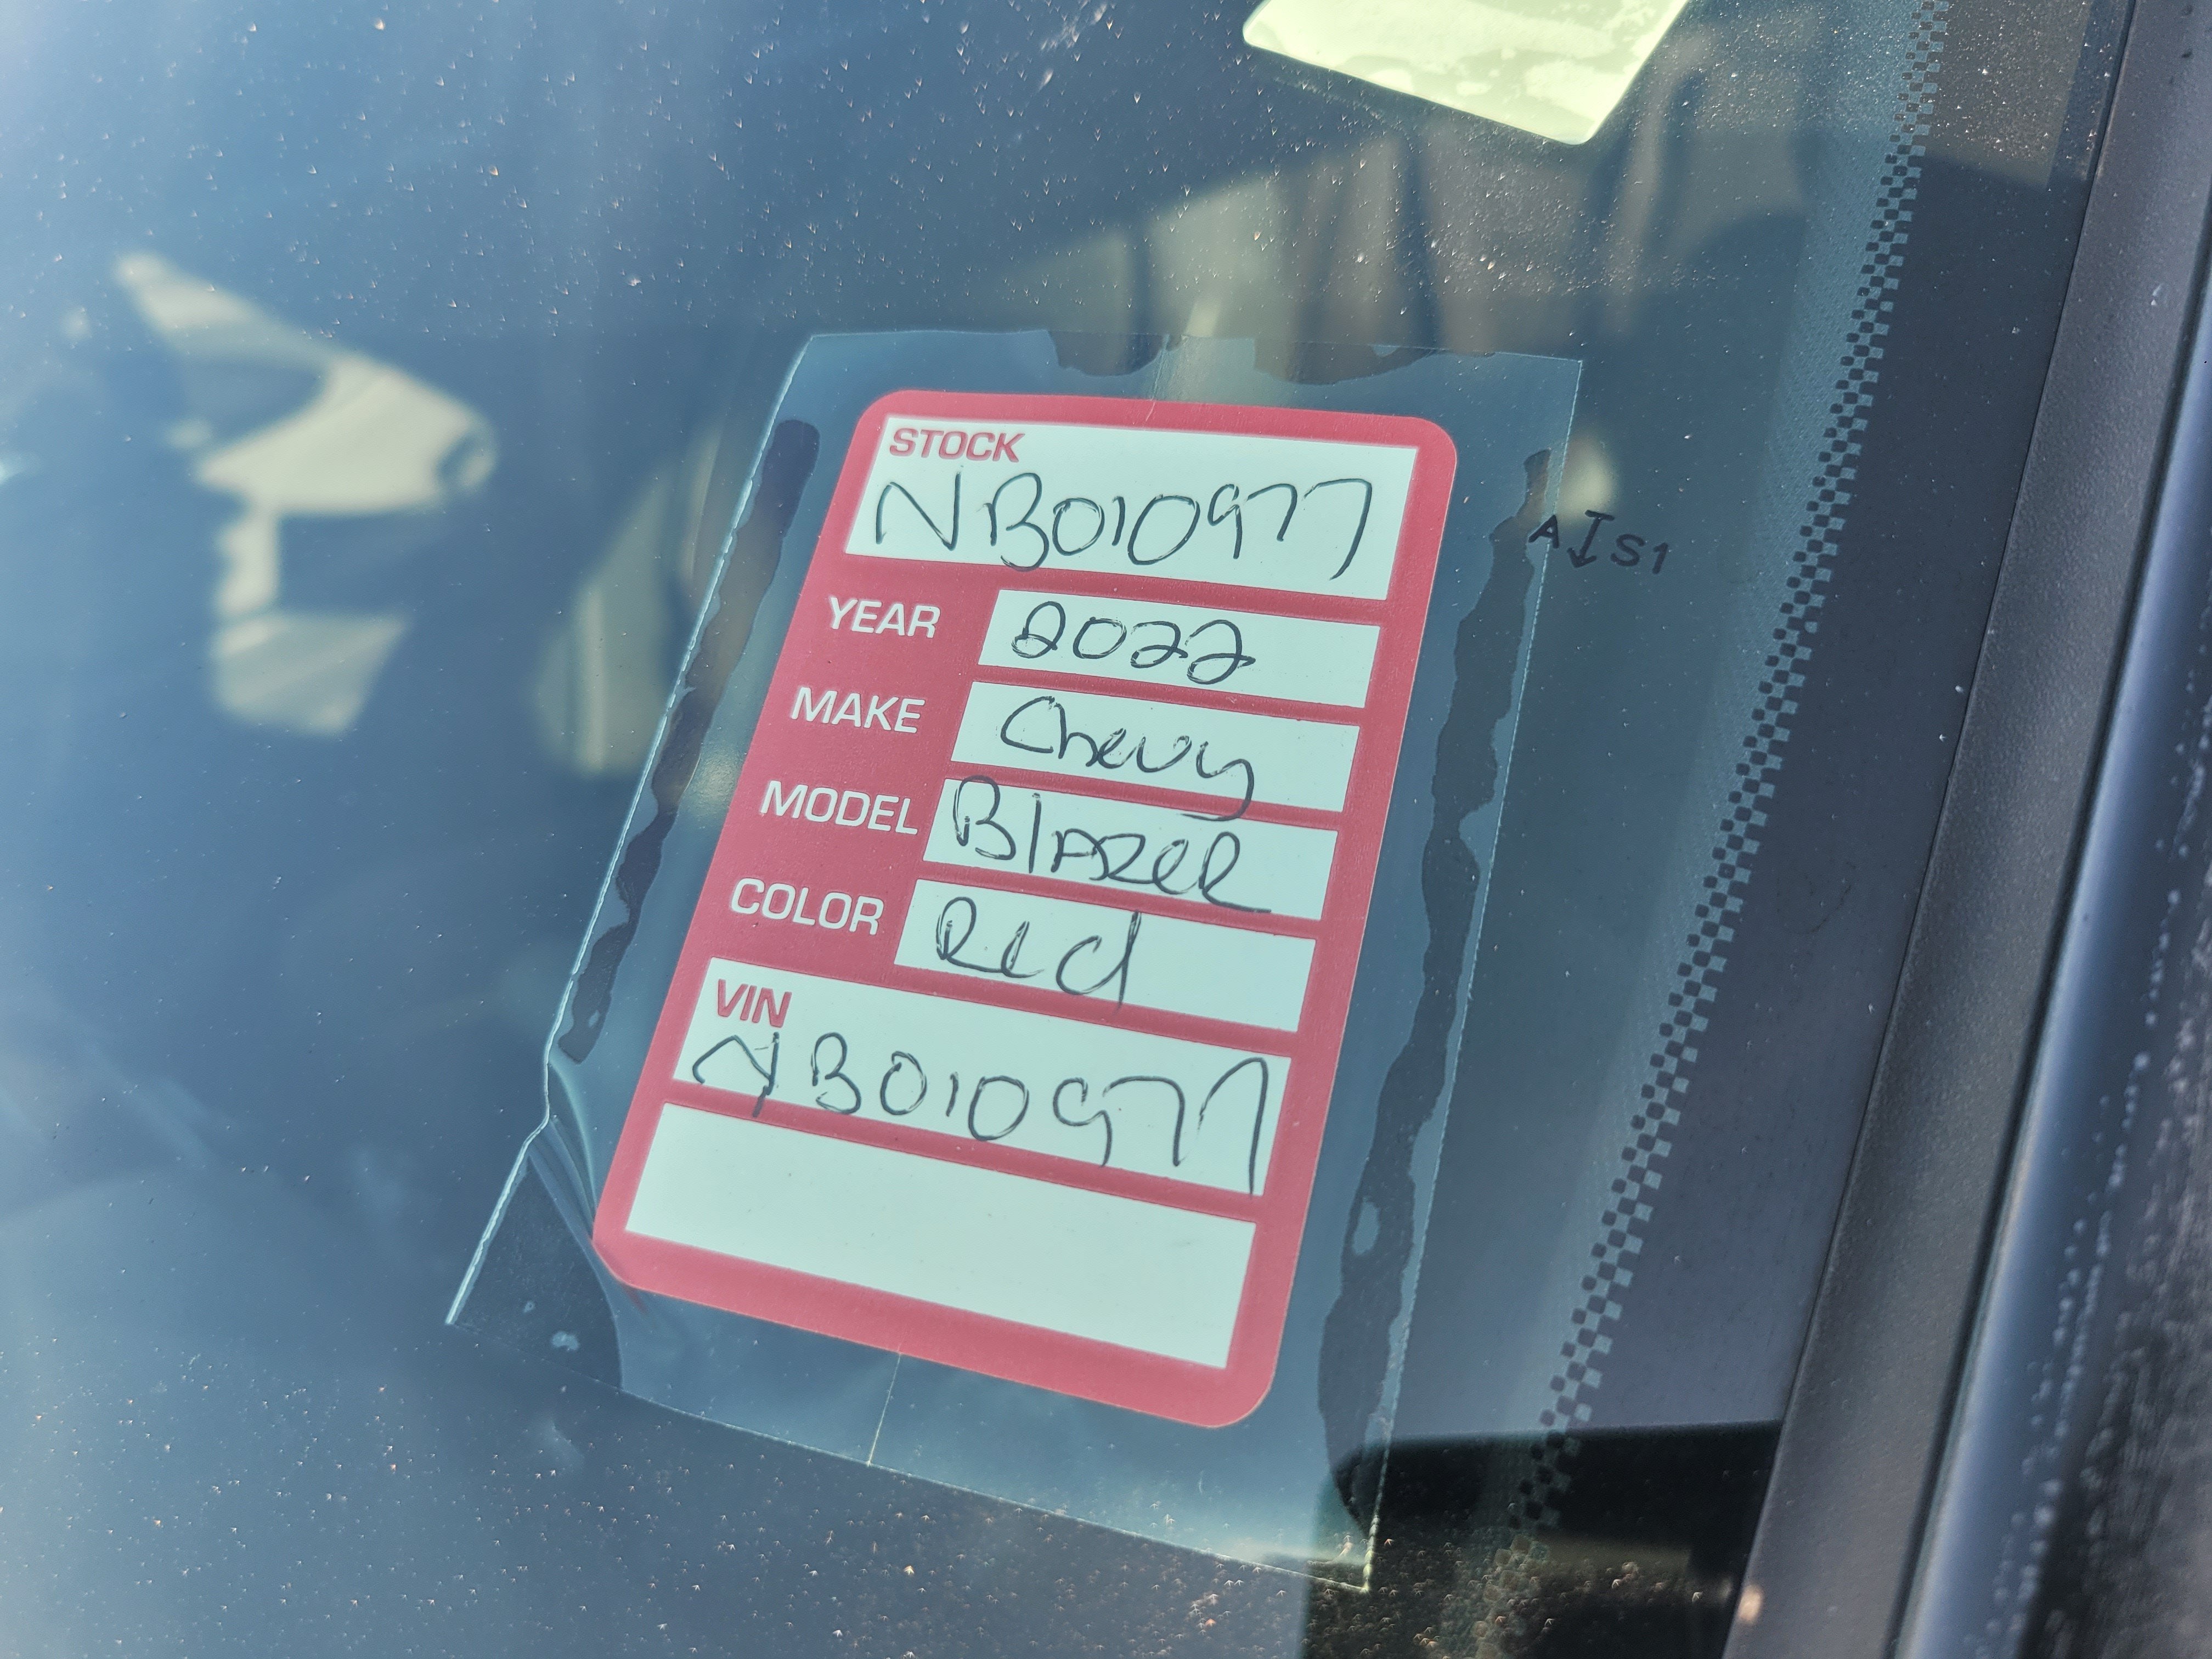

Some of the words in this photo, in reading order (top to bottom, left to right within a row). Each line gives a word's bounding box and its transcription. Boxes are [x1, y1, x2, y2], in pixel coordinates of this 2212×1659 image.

[889, 427, 1025, 462] STOCK
[875, 471, 1373, 580] NB010977
[1528, 514, 1559, 549] A
[828, 597, 941, 639] YEAR
[1011, 601, 1256, 685] 2022
[790, 686, 926, 733] MAKE
[1000, 696, 1255, 822] Chevy
[760, 780, 919, 835] MODEL
[730, 878, 884, 935] COLOR
[936, 896, 1142, 1011] Red
[716, 979, 792, 1028] VIN
